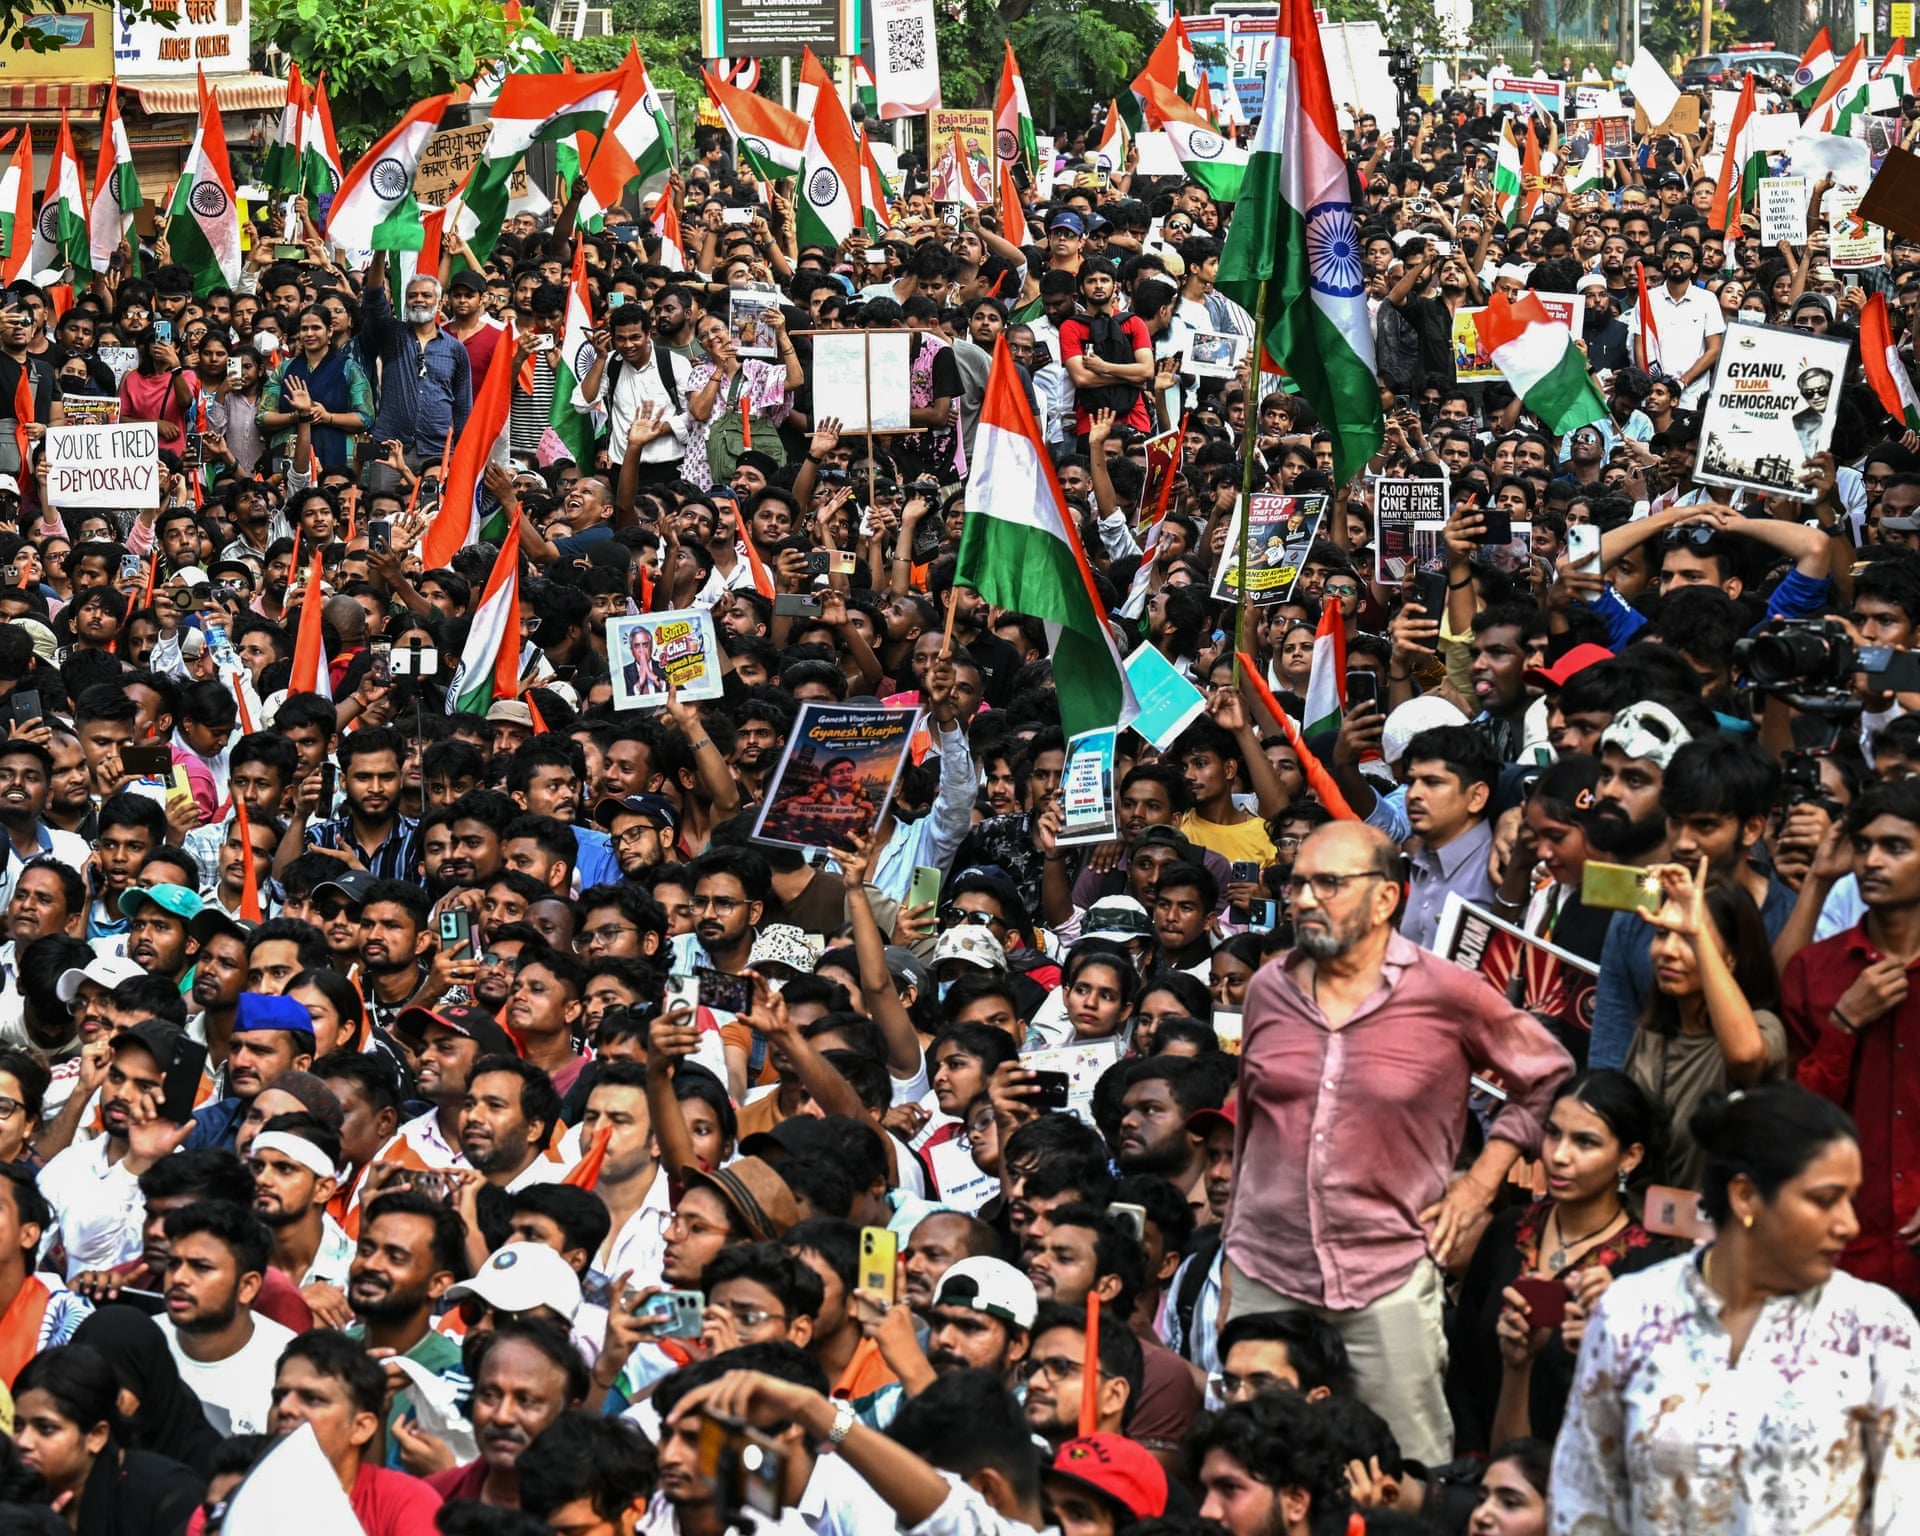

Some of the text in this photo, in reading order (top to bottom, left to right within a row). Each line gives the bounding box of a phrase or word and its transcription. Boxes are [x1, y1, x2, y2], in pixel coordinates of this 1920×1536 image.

[158, 37, 192, 61] AMOGH
[195, 34, 230, 59] CORNER
[938, 114, 988, 126] Raja ki jaan
[974, 126, 986, 135] hai
[1727, 362, 1786, 381] GYANU,
[1734, 379, 1769, 390] TUJHA
[1719, 394, 1799, 411] DEMOCRACY
[112, 429, 156, 459] FIRED
[1381, 484, 1443, 497] 4,000 EVMs.
[1253, 498, 1292, 509] STOP
[1381, 497, 1442, 511] ONE FIRE.
[1381, 511, 1443, 519] MANY QUESTIONS.
[655, 623, 689, 645] 1 Sutta
[660, 638, 687, 667] 2 Chai
[665, 658, 688, 673] Gyanesh
[818, 714, 847, 723] Ganesh
[849, 713, 876, 725] Visarjan
[808, 723, 905, 742] Gyanesh Visarjan.
